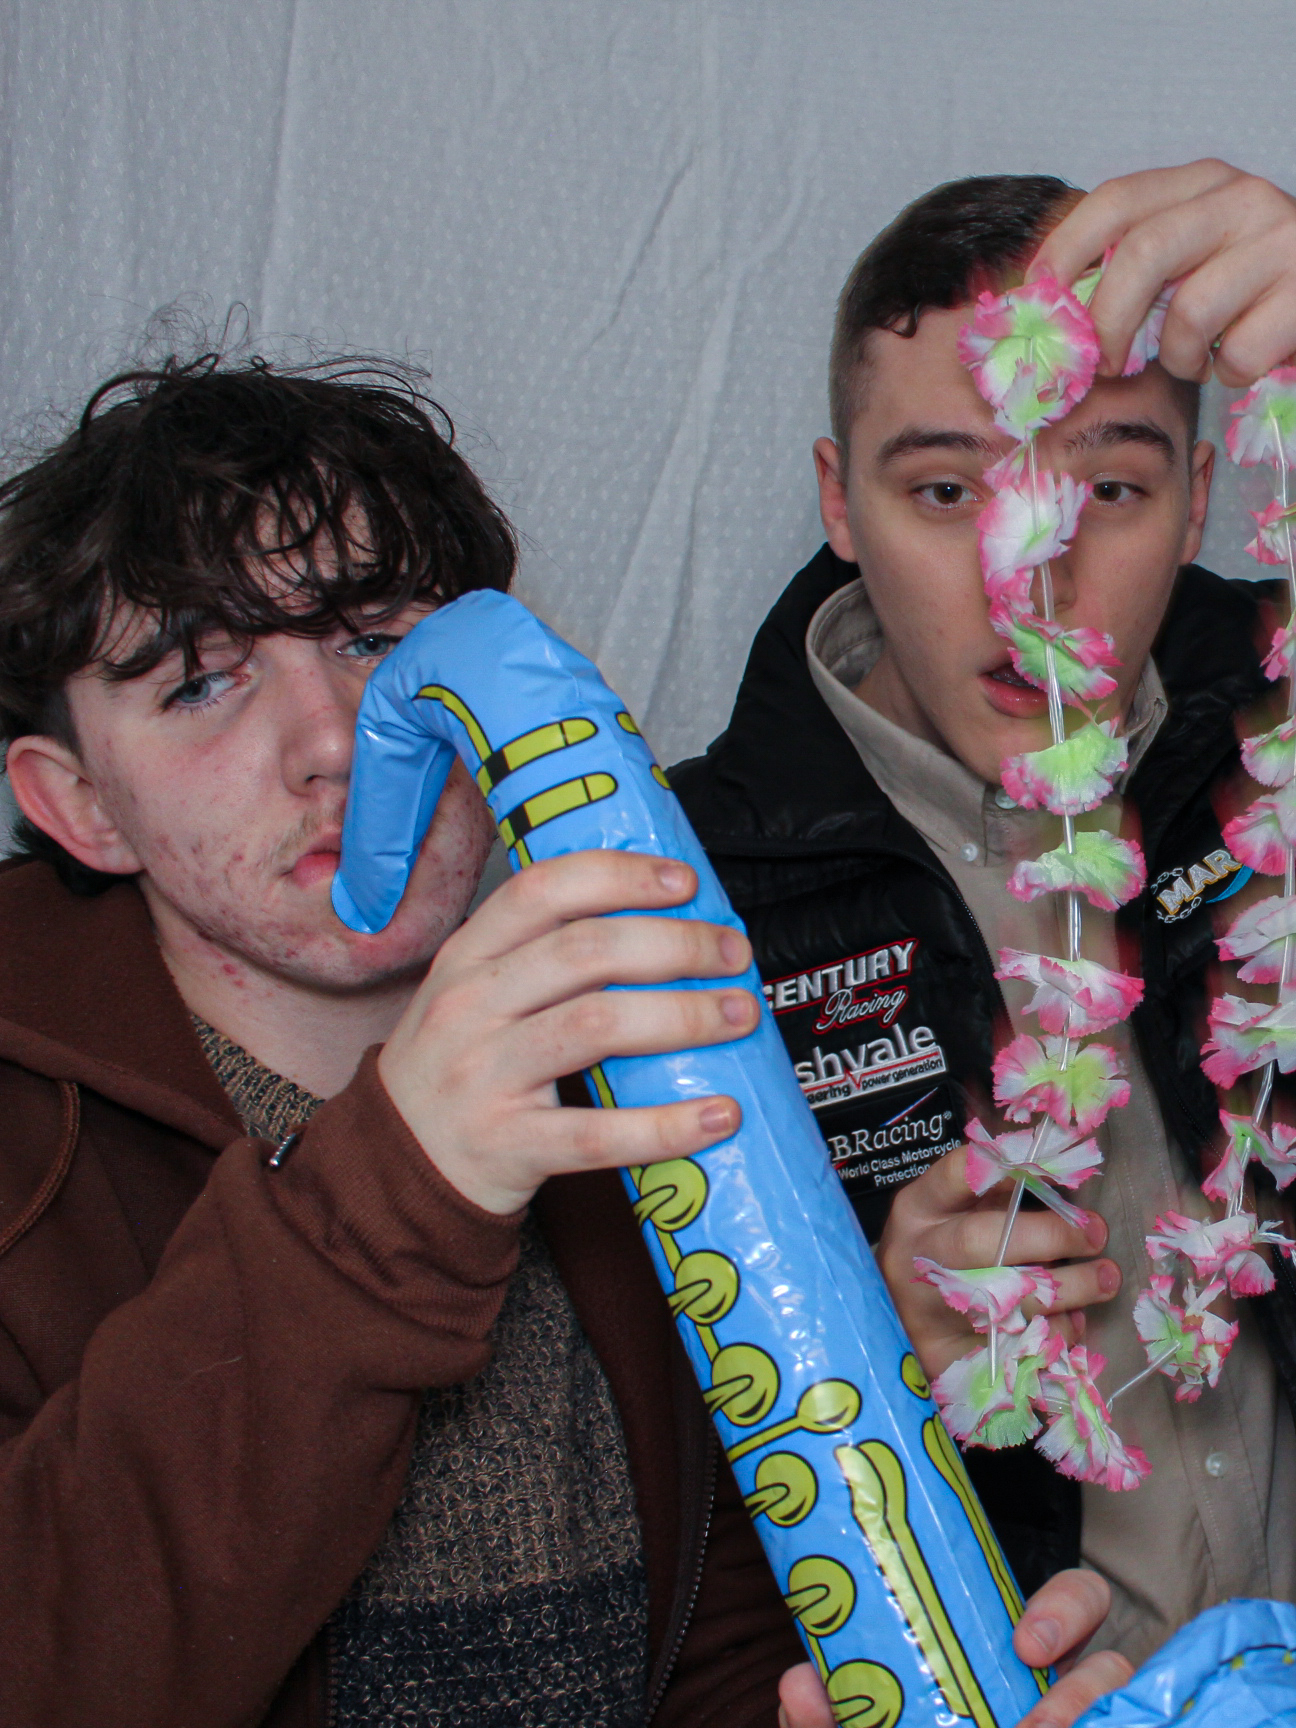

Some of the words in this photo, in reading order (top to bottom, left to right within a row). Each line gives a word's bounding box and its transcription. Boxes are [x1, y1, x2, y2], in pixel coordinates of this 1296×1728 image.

[816, 986, 907, 1030] Racing
[862, 1073, 891, 1091] power
[892, 1058, 943, 1082] generation
[838, 1161, 870, 1180] World
[870, 1156, 901, 1172] Class
[901, 1138, 961, 1164] Motorcycle
[874, 1163, 931, 1187] Protection
